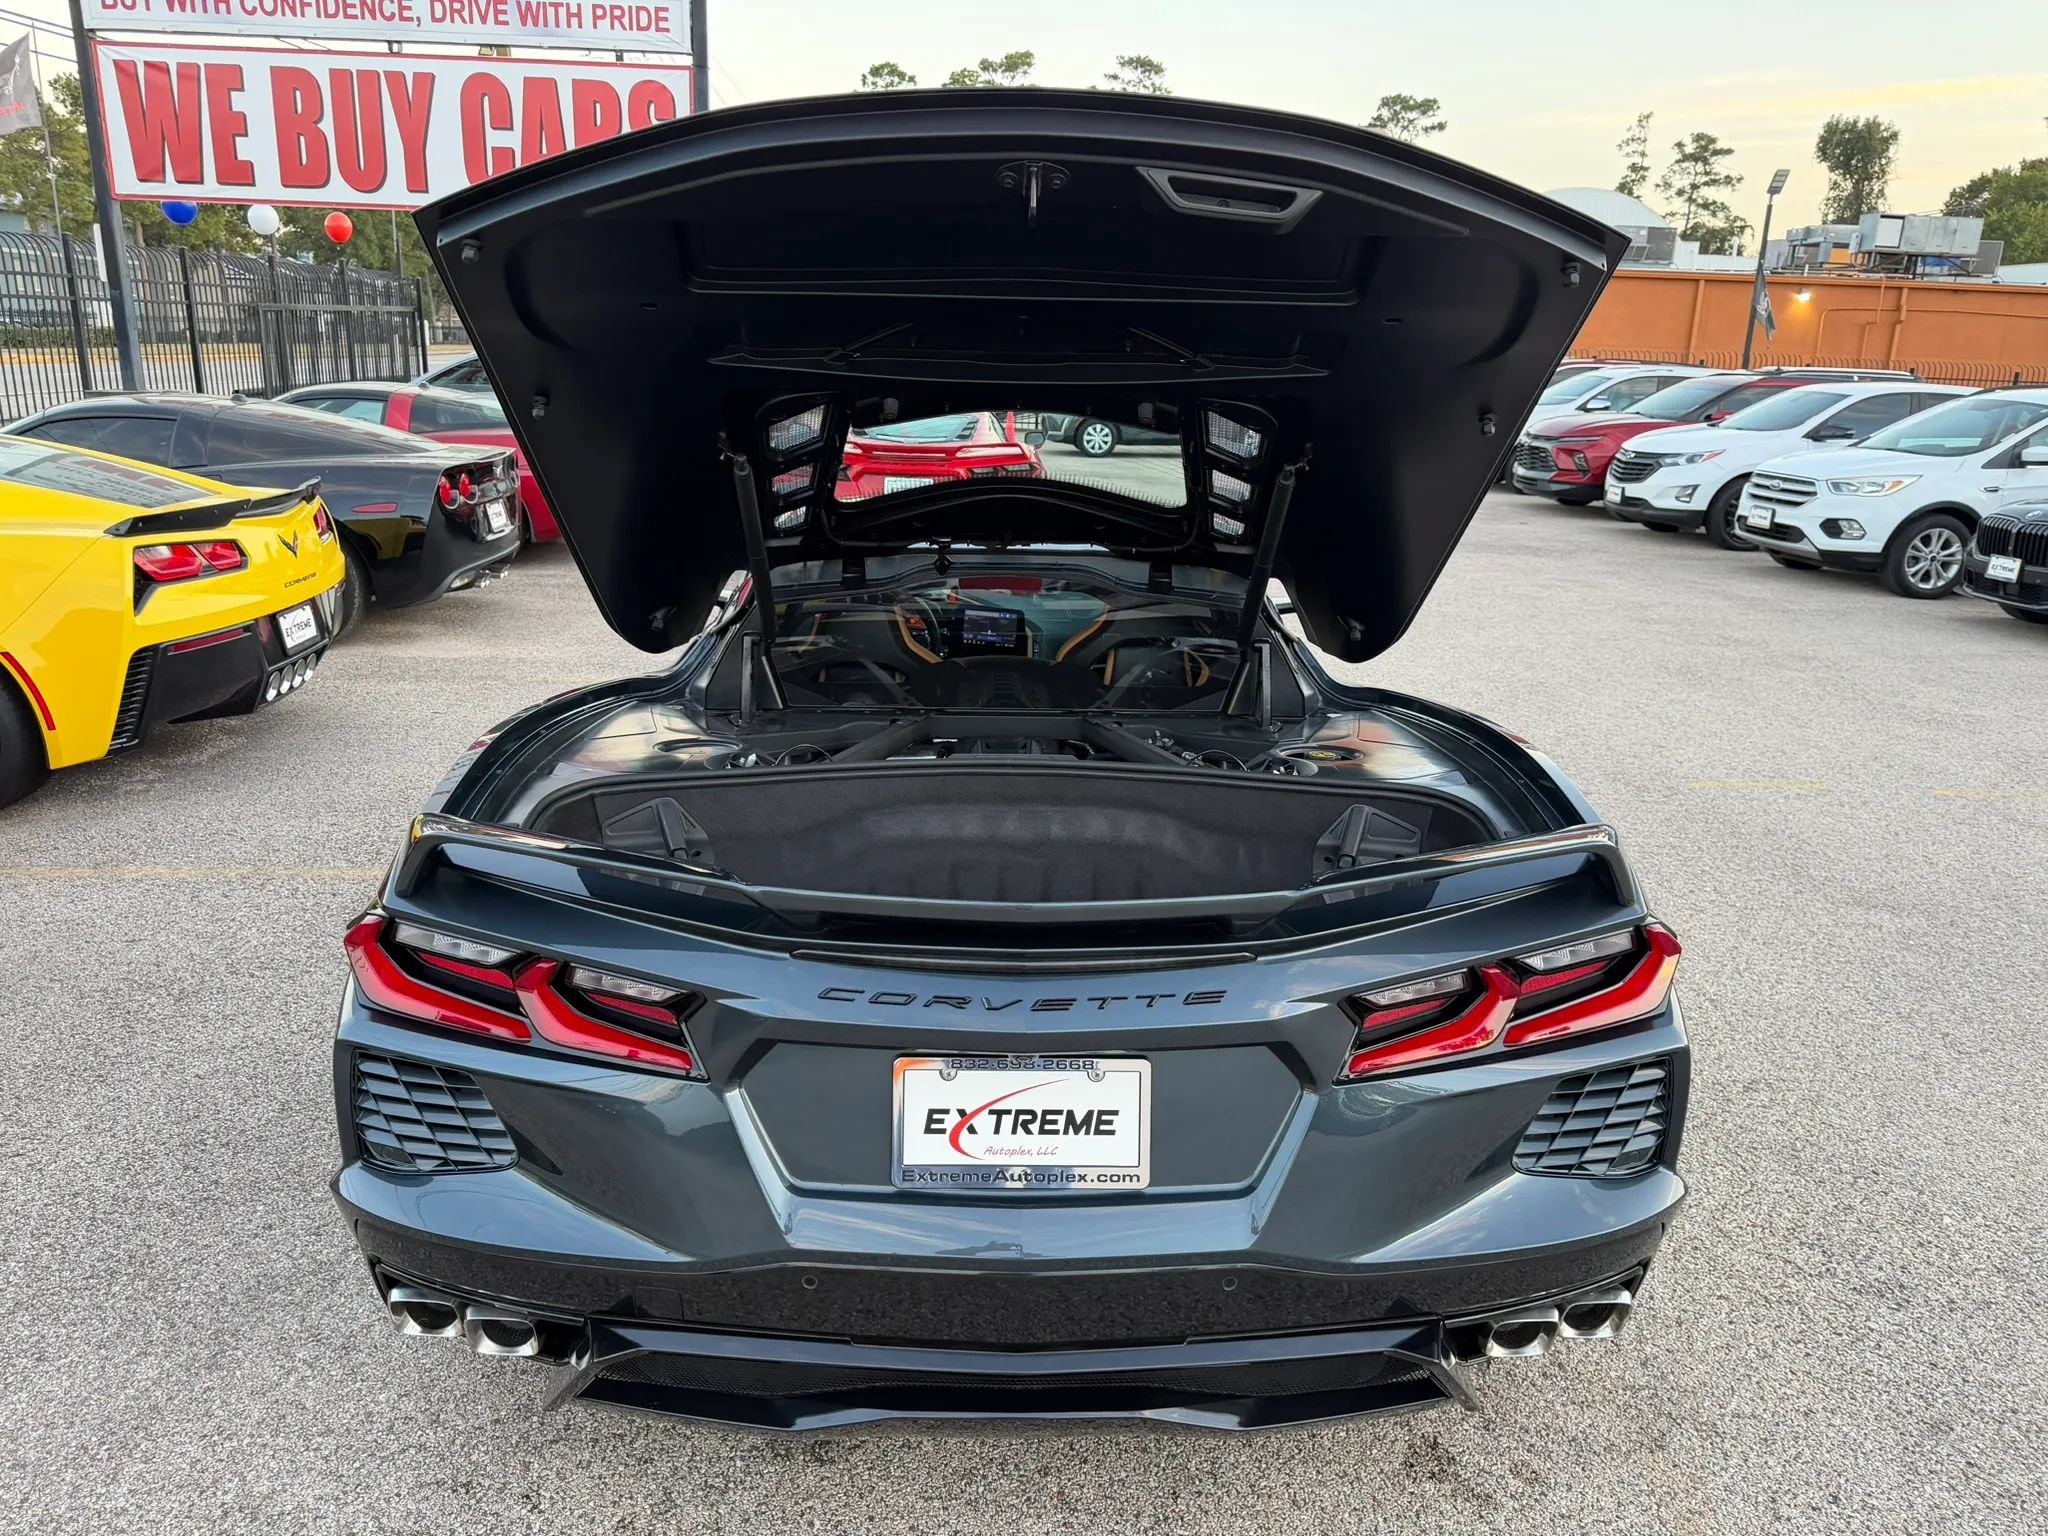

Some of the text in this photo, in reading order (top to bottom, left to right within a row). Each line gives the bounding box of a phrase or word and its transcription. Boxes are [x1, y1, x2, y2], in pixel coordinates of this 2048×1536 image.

[430, 0, 511, 26] DRIVE
[514, 0, 583, 29] WITH
[591, 4, 671, 33] PRIDE
[113, 59, 254, 184] WE
[269, 65, 436, 193] BUY
[817, 986, 1228, 1012] CORVETTE
[923, 1108, 1120, 1136] EXTREME
[983, 1145, 1059, 1158] Autoplex, LLC
[902, 1168, 1141, 1184] ExtremeAutoplex.com
